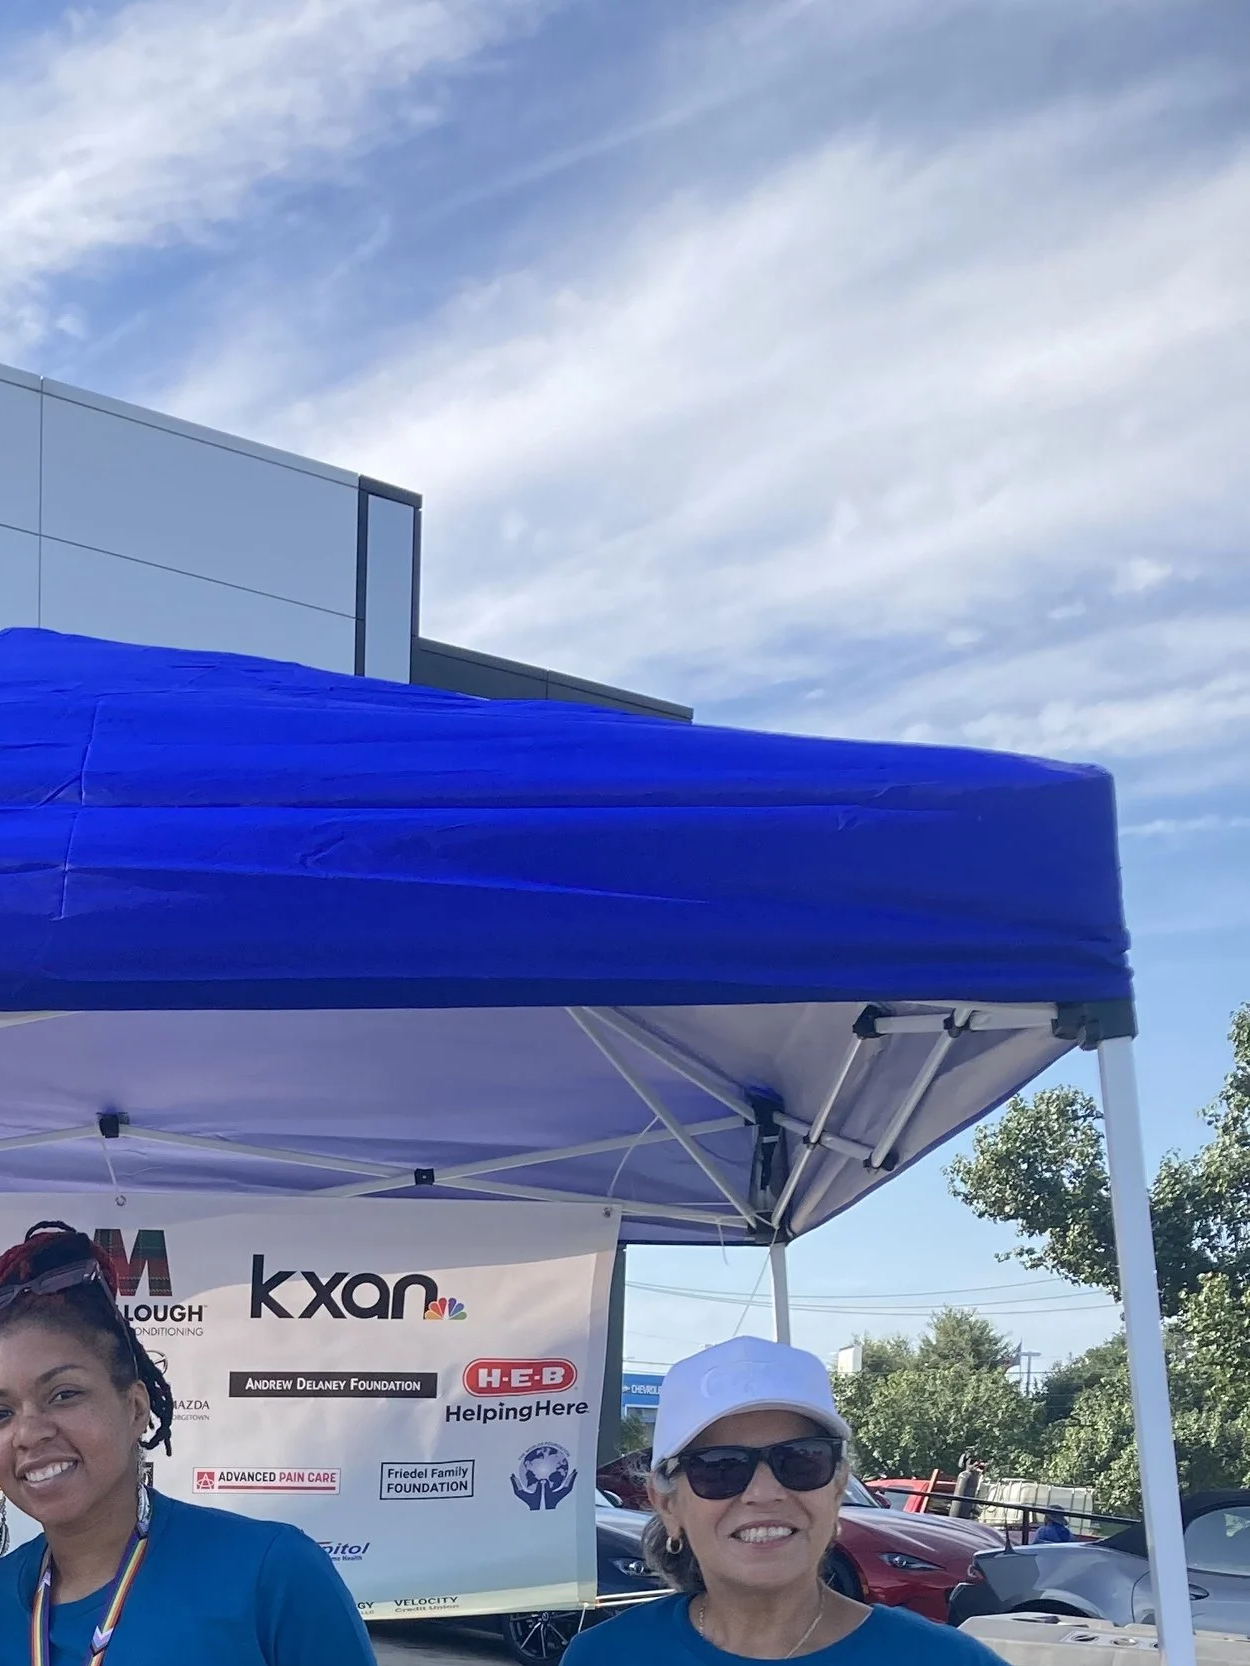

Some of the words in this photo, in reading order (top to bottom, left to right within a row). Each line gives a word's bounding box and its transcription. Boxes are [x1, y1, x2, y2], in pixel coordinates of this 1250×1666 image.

[250, 1254, 438, 1320] kxan
[124, 1304, 204, 1322] LOUGH
[134, 1327, 204, 1336] ONDITIONING
[478, 1366, 566, 1388] H-E-B
[245, 1377, 292, 1390] ANDREW
[297, 1378, 346, 1390] DELANEY
[350, 1378, 421, 1391] FOUNDATION
[218, 1471, 276, 1482] ADVANCED
[279, 1472, 304, 1482] PAIN
[307, 1472, 337, 1483] CARE
[387, 1468, 427, 1479] Friedel
[431, 1466, 468, 1478] Family
[387, 1480, 468, 1493] FOUNDATION
[393, 1596, 459, 1606] VELOCITY
